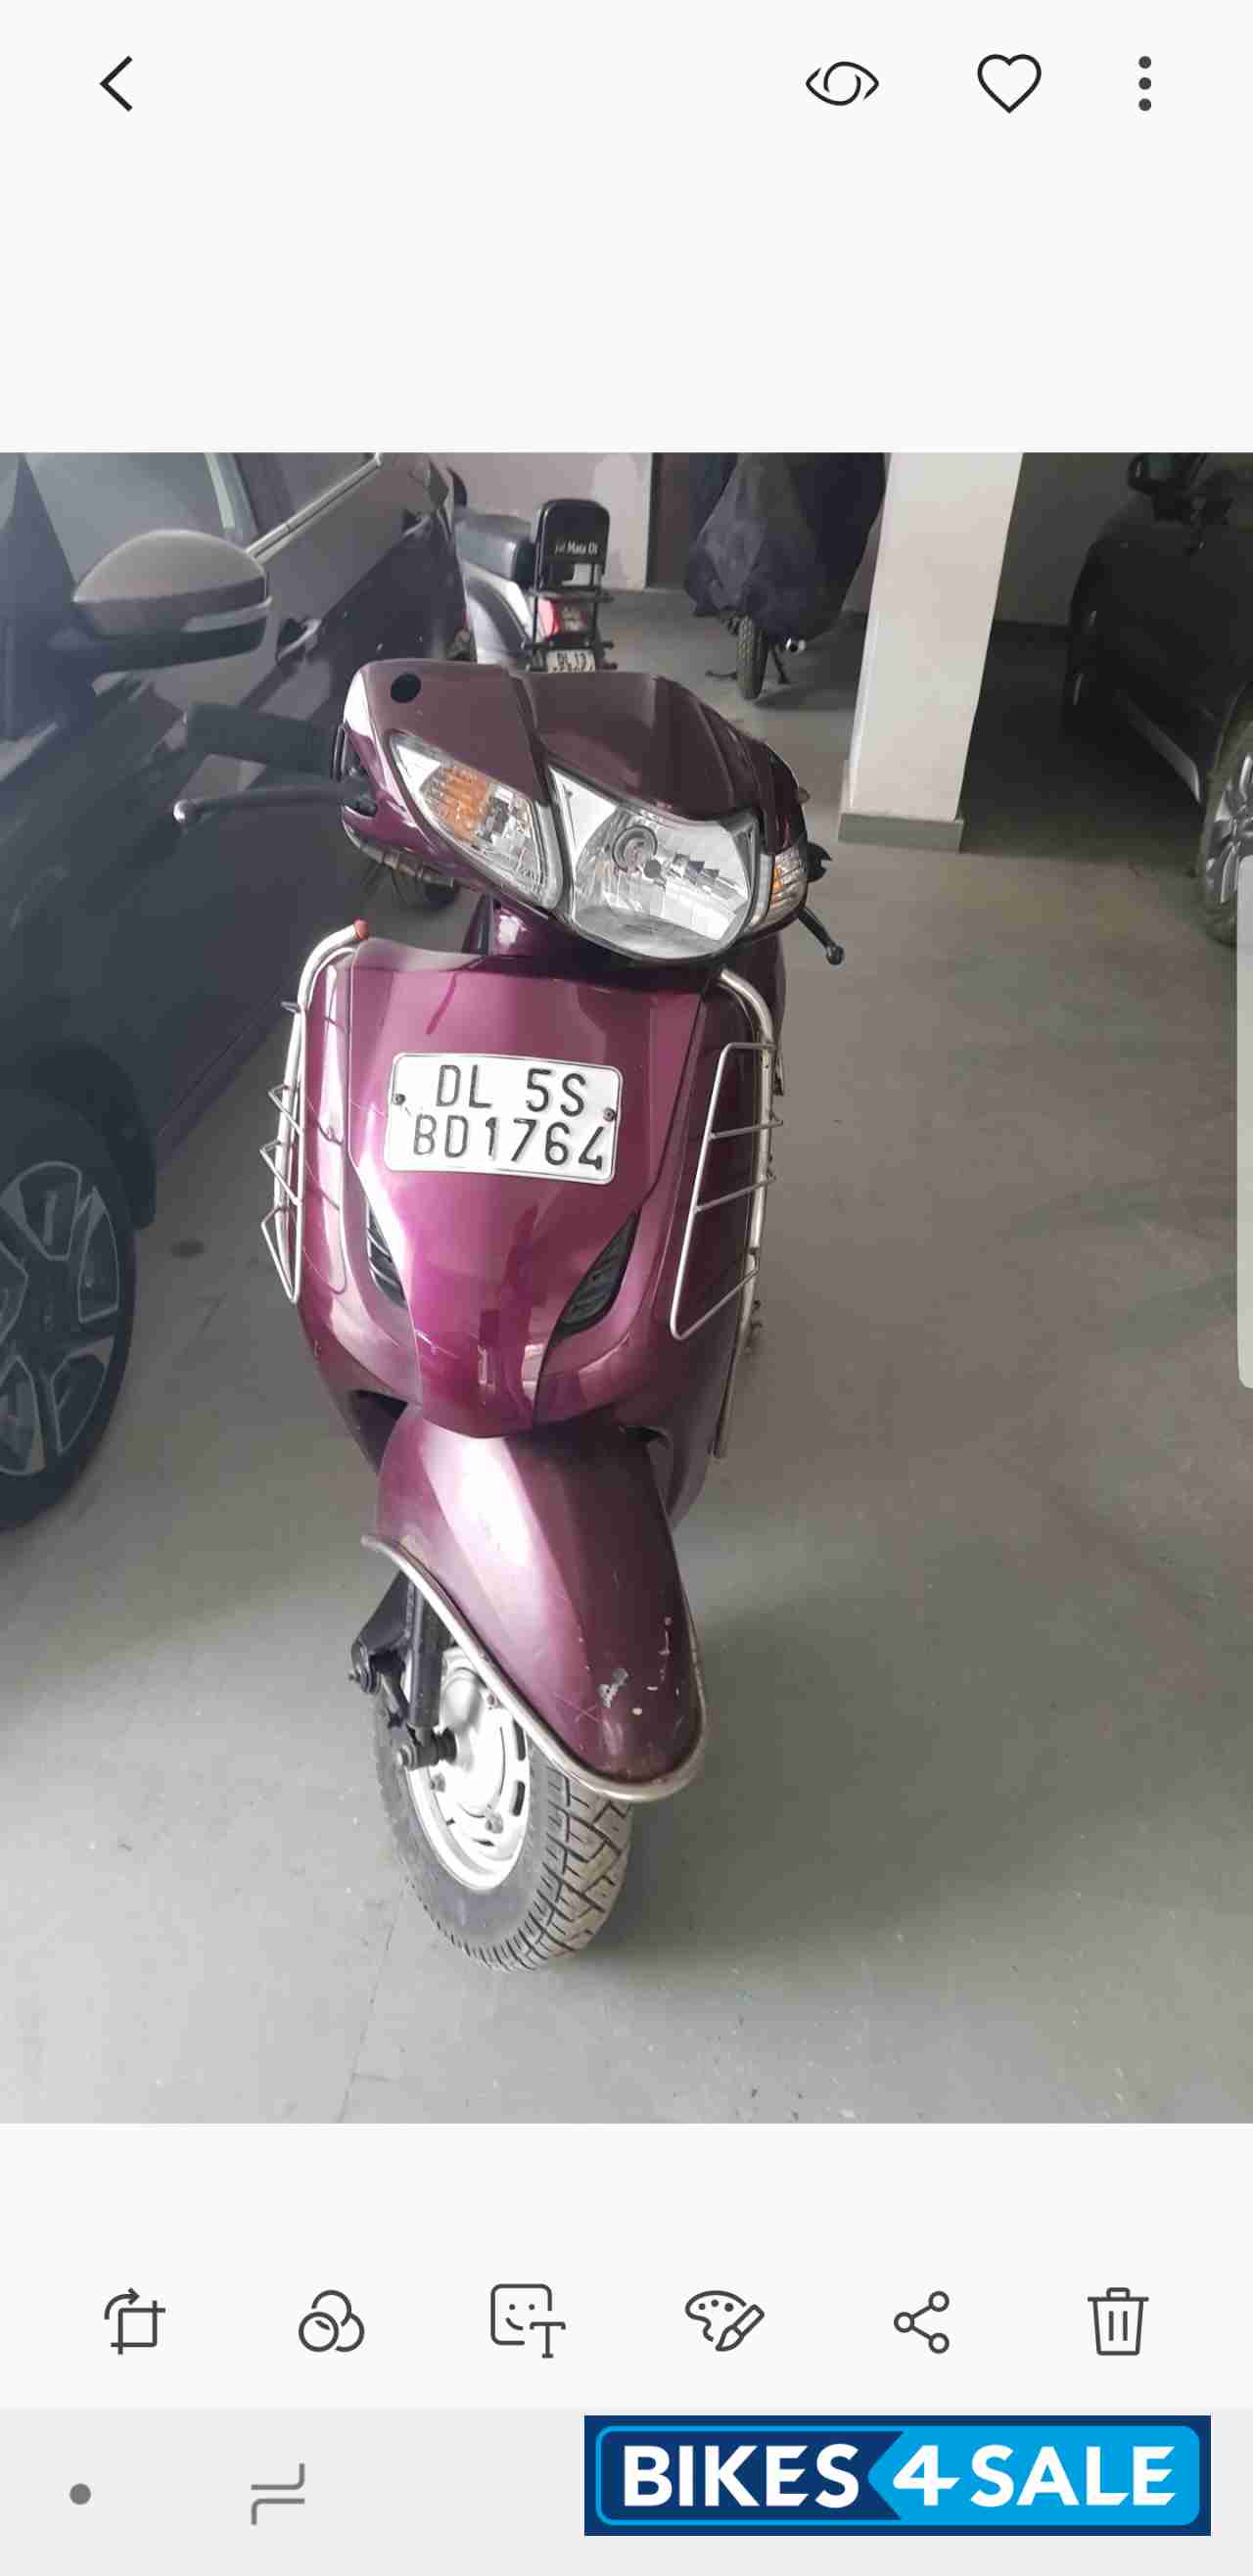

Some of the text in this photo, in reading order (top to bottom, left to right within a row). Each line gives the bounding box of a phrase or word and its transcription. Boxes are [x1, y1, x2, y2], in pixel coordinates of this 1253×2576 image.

[436, 1064, 586, 1117] DL 5S
[413, 1113, 605, 1170] BD1764
